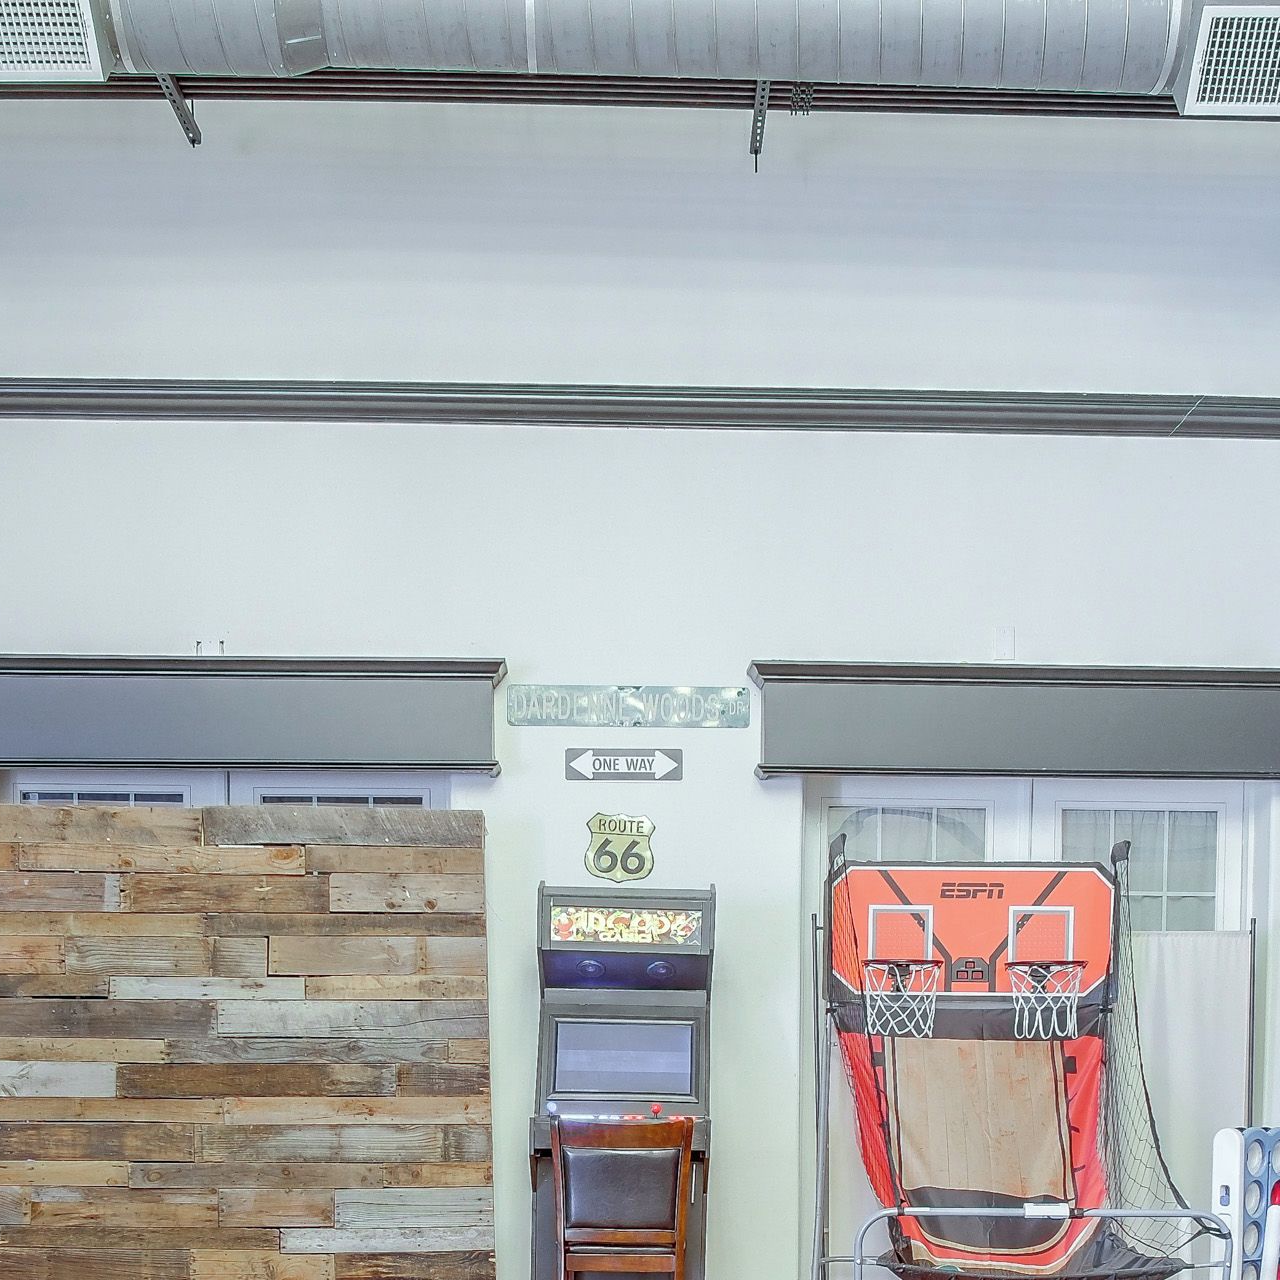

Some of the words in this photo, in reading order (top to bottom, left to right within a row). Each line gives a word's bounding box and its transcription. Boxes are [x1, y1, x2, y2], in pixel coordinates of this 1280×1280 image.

[513, 692, 632, 721] DARDENNE
[641, 693, 720, 722] WOODS
[592, 758, 620, 771] ONE
[625, 758, 655, 771] WAY
[598, 818, 645, 834] ROUTE
[593, 838, 646, 875] 66
[940, 882, 1004, 899] ESPN
